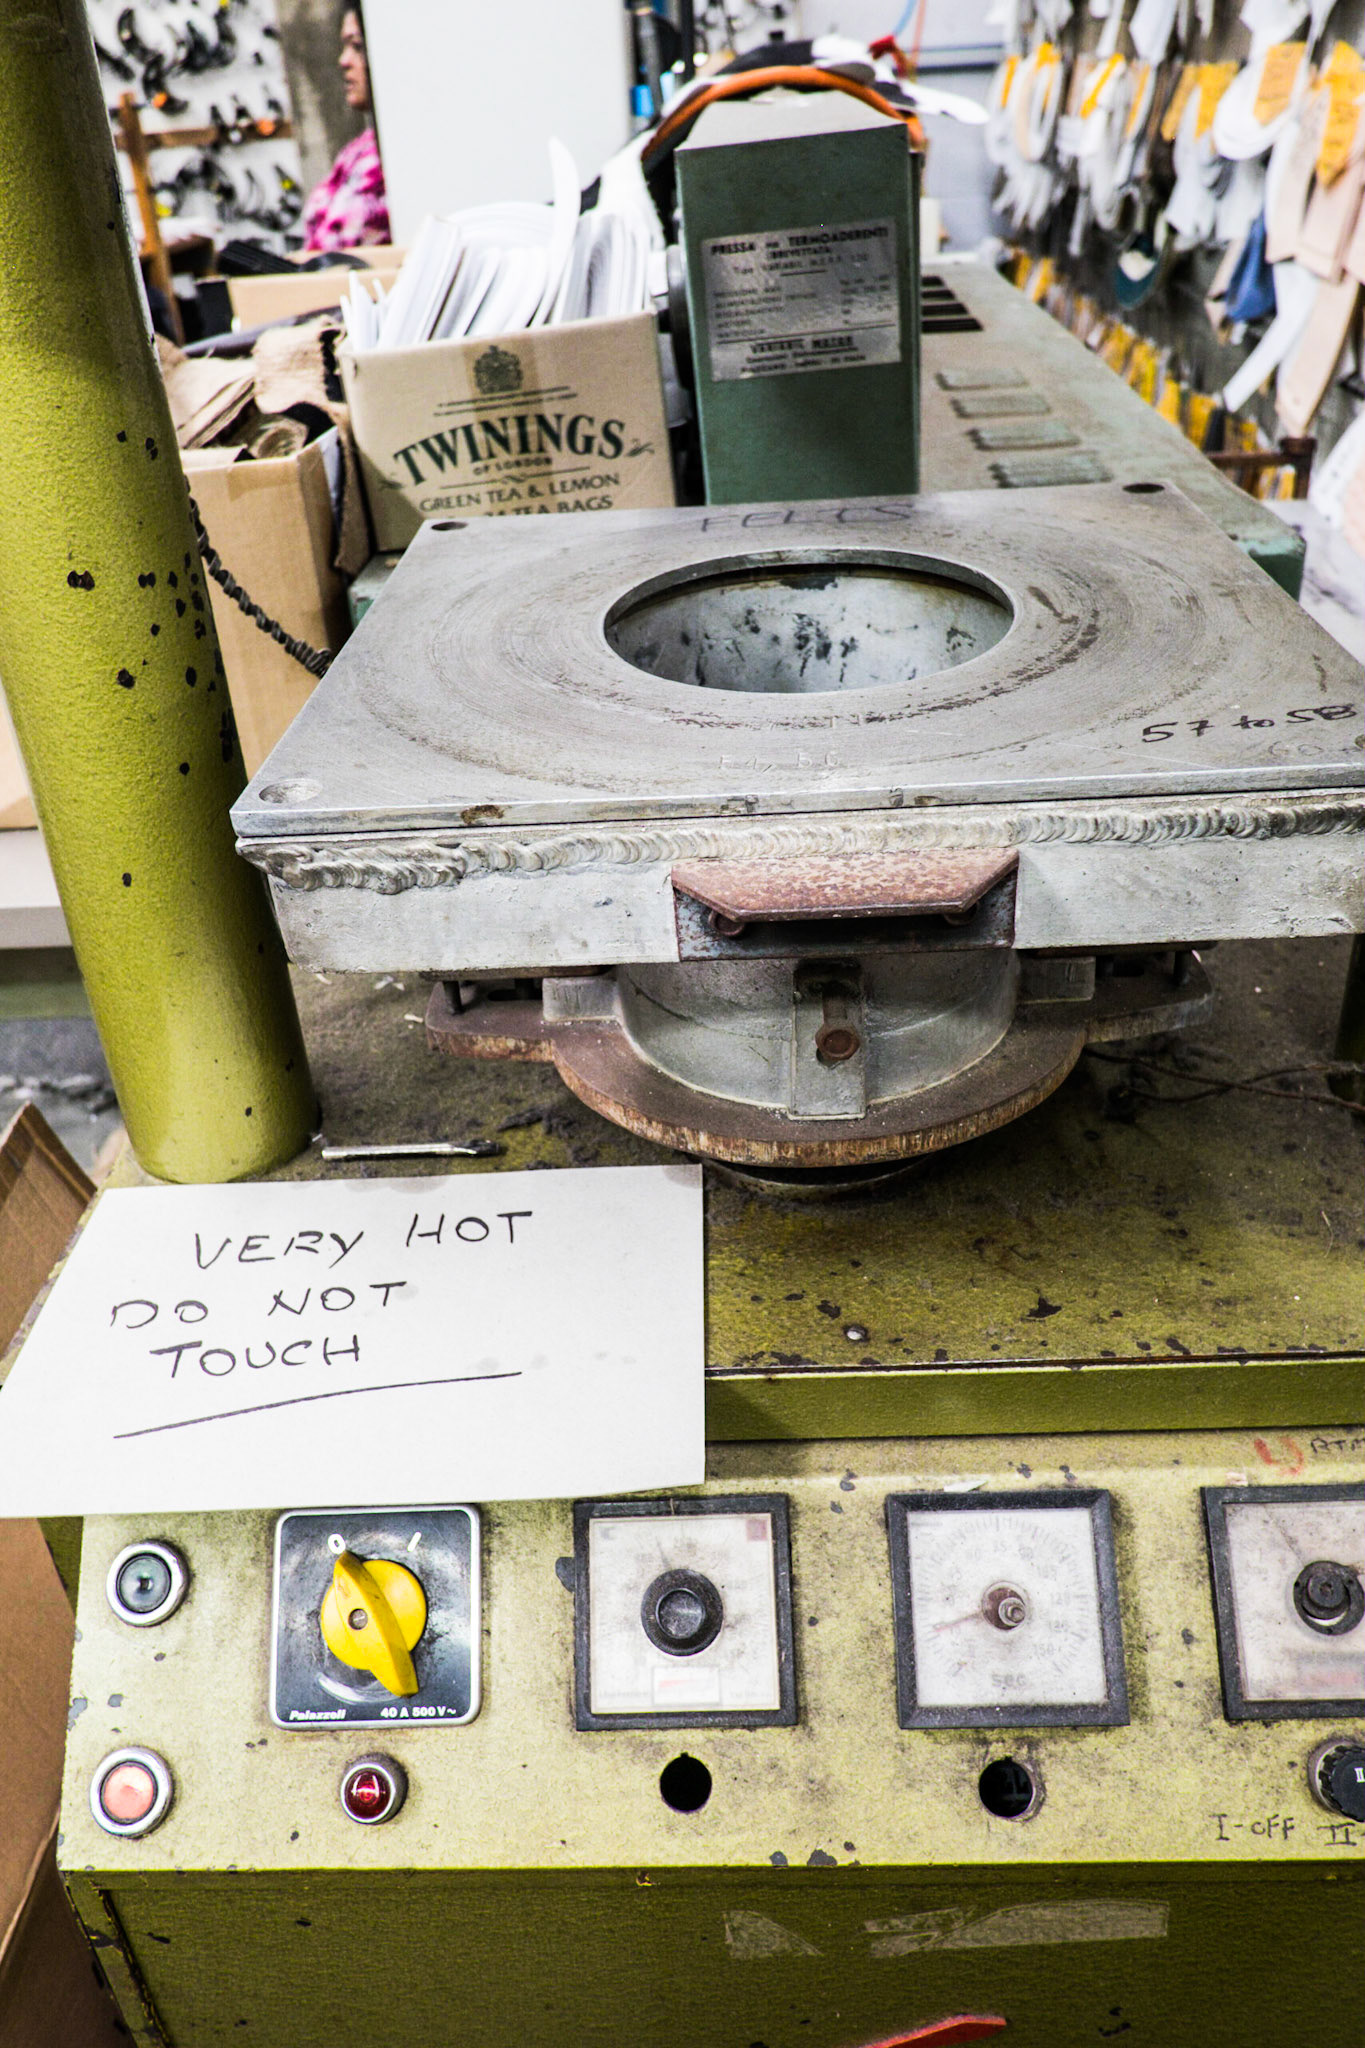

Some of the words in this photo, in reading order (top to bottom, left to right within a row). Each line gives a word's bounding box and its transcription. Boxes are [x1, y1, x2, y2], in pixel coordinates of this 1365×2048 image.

[393, 414, 626, 486] TWININGS
[472, 463, 492, 477] OF
[495, 456, 554, 471] LONDON
[419, 491, 481, 513] GREEN
[486, 485, 522, 504] TEA
[527, 483, 545, 499] &
[549, 472, 621, 495] LEMON
[556, 494, 614, 513] BAGS
[1231, 715, 1275, 730] to
[194, 1230, 364, 1270] VERY
[406, 1211, 533, 1247] HOT
[110, 1299, 209, 1329] DO
[267, 1281, 407, 1317] NOT
[150, 1335, 361, 1378] TOUCH
[289, 1708, 347, 1721] Palazzoli
[380, 1706, 398, 1718] 40
[399, 1706, 409, 1718] A
[412, 1706, 436, 1718] 500
